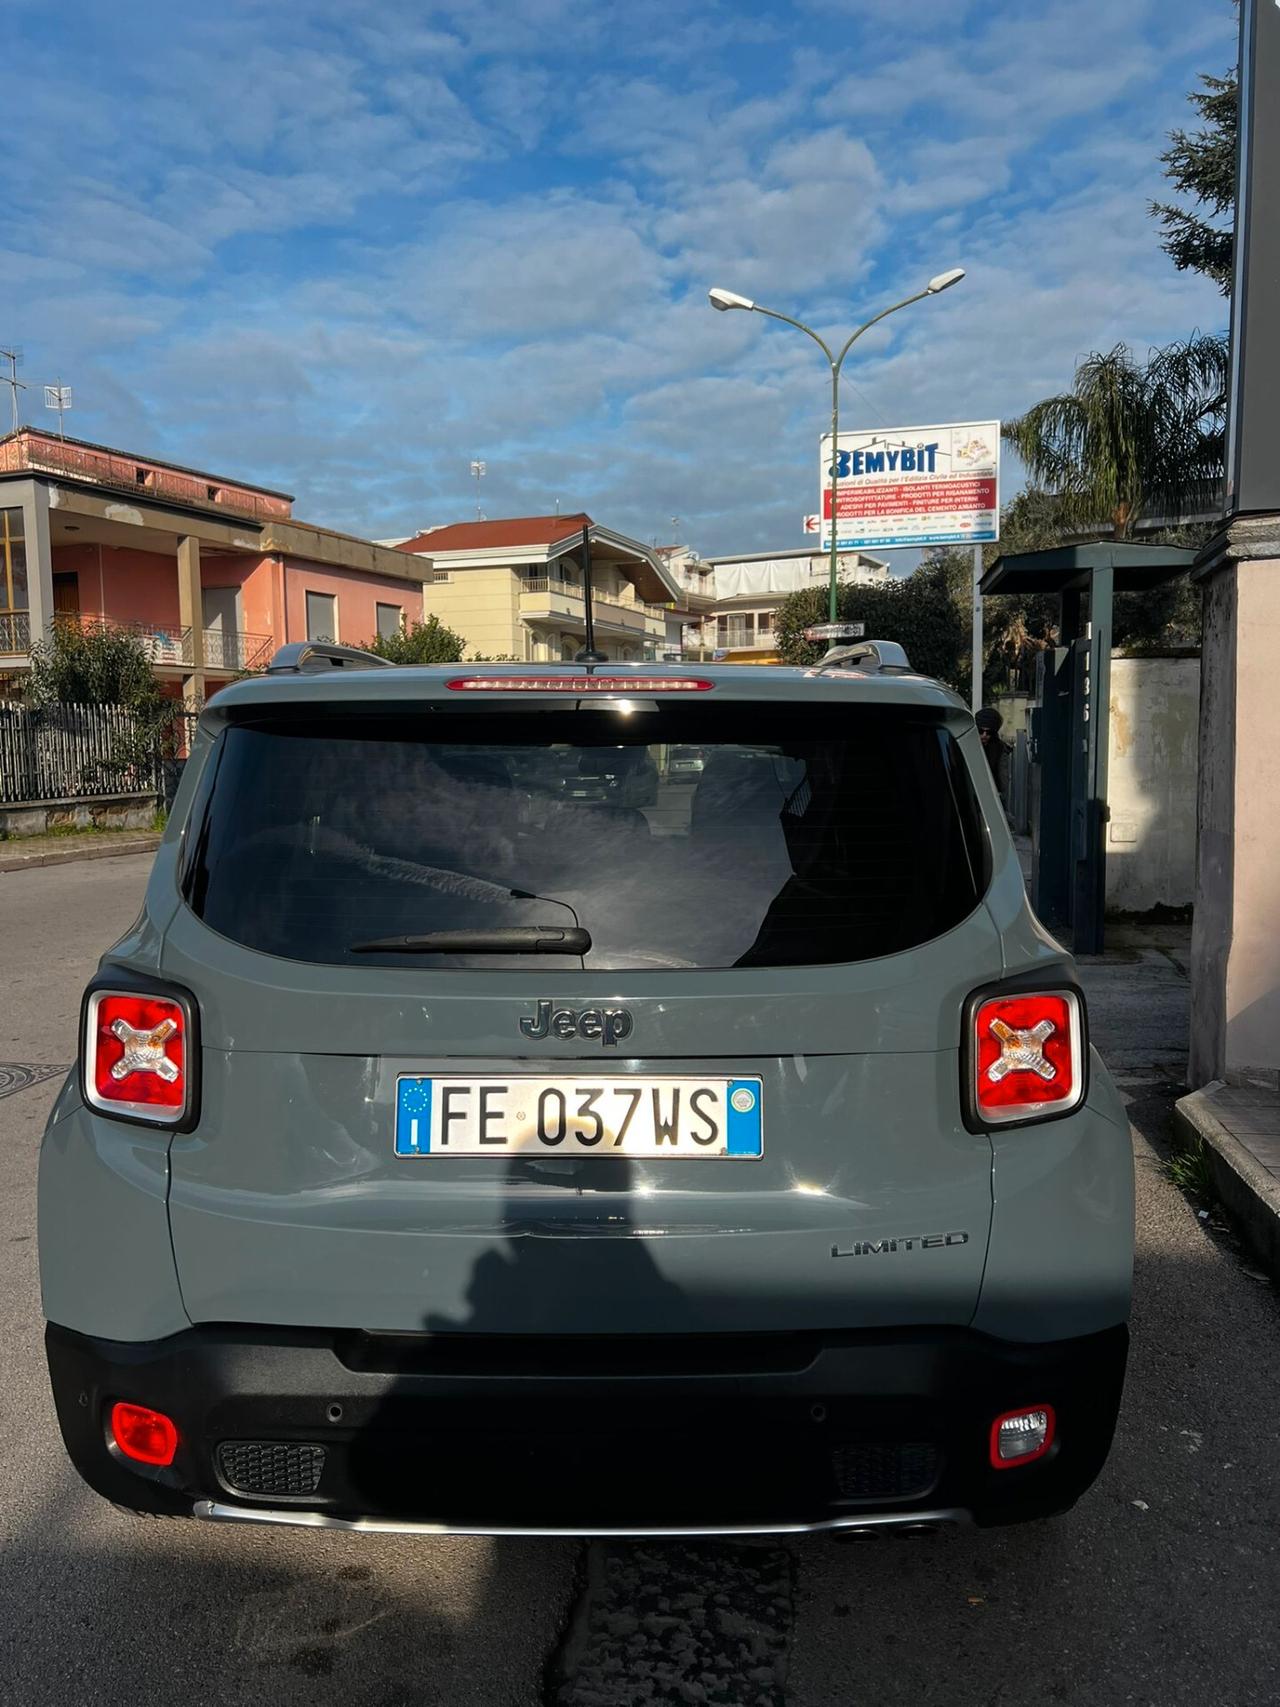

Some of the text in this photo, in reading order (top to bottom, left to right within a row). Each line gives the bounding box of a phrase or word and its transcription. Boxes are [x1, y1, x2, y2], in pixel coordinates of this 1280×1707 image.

[828, 493, 896, 503] CNTROSOFFITTATURE
[900, 491, 930, 499] PRODOTTI
[945, 488, 990, 496] RISANAMENTO
[931, 481, 980, 490] TERMOACUSTICI
[519, 999, 635, 1048] Jeep
[441, 1086, 509, 1145] FE
[831, 1230, 969, 1258] LIMITED
